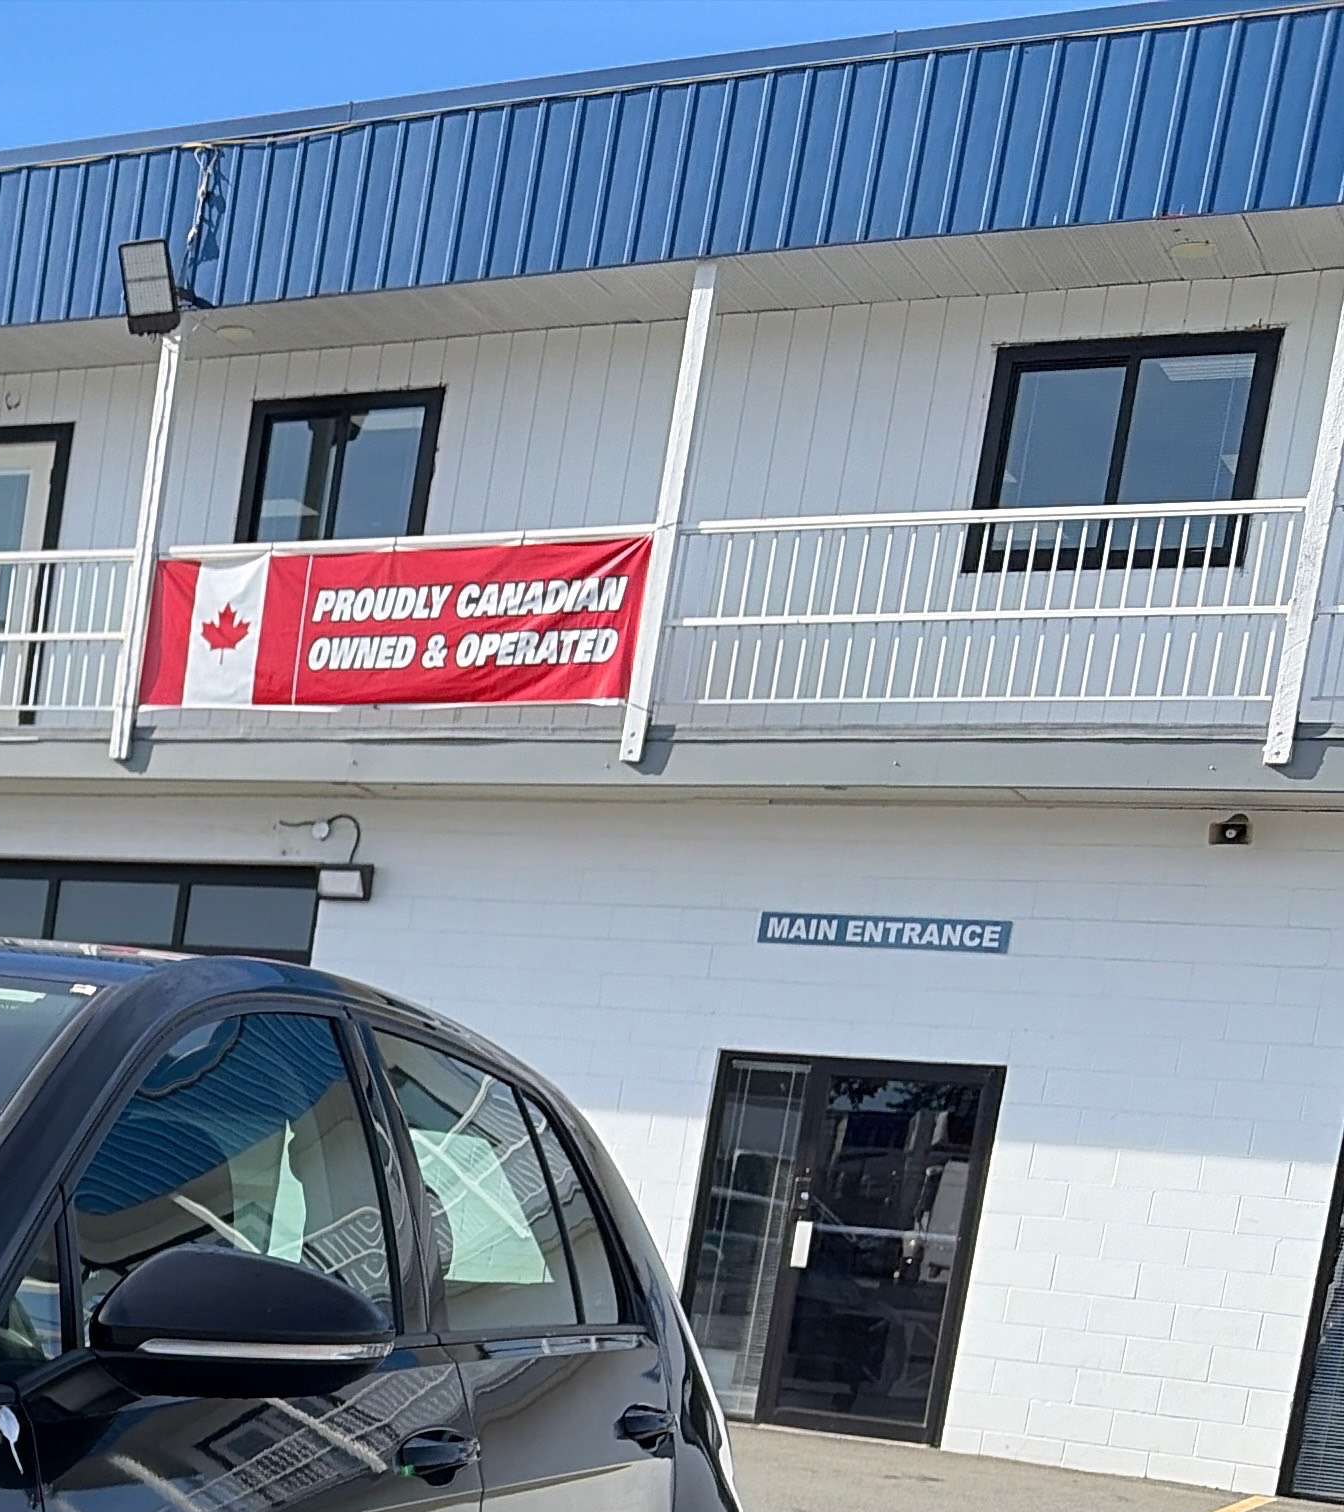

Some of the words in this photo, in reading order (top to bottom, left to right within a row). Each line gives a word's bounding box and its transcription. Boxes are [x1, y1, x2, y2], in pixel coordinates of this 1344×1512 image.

[312, 584, 453, 622] PROUDLY
[456, 576, 628, 618] CANADIAN
[308, 635, 416, 670] OWNED
[422, 634, 448, 668] &
[456, 628, 619, 667] OPERATED
[766, 916, 838, 941] MAIN
[845, 920, 1002, 948] ENTRANCE
